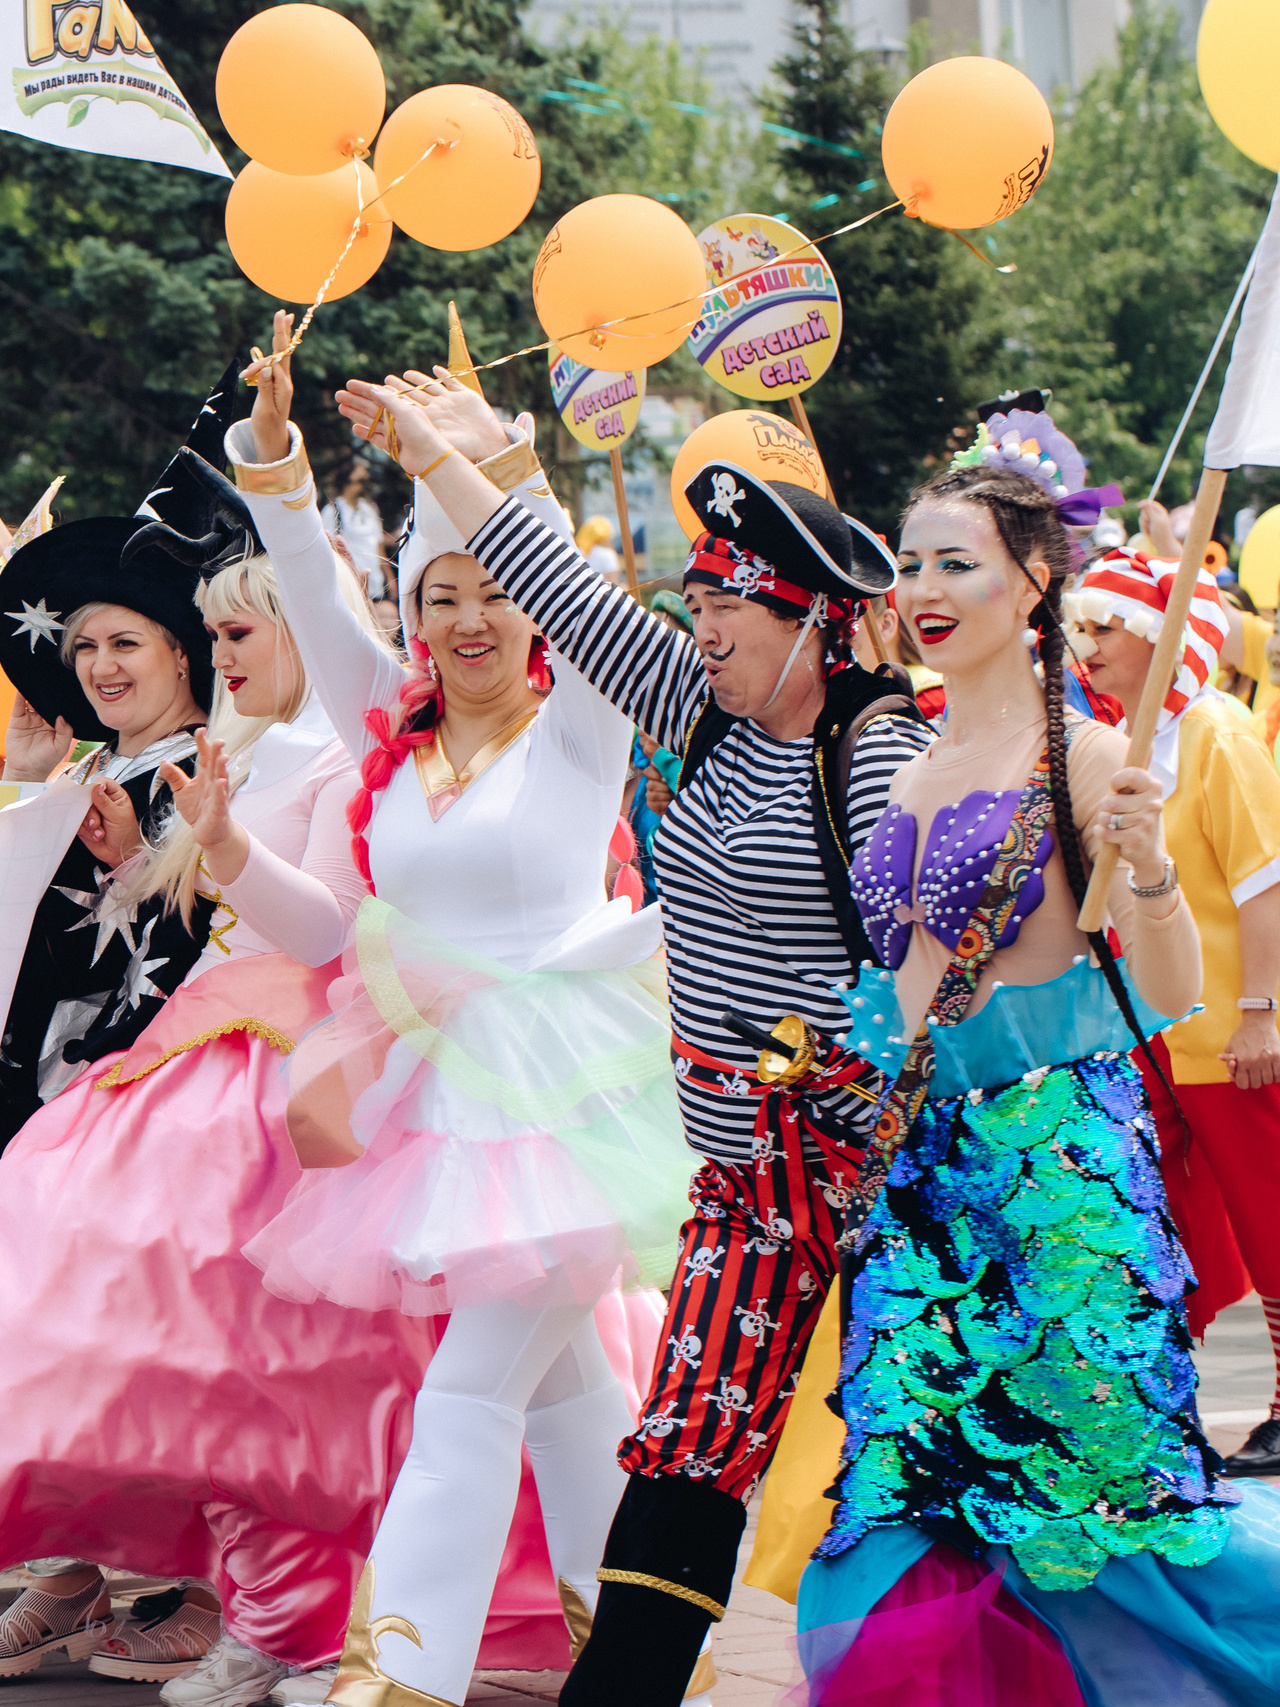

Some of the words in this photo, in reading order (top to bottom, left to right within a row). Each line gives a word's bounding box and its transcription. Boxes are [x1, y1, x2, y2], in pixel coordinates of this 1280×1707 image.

[23, 83, 40, 98] Мы
[41, 76, 65, 94] рады
[67, 71, 99, 86] видеть
[101, 71, 117, 84] Вас
[119, 75, 125, 85] в
[126, 75, 157, 93] нашем
